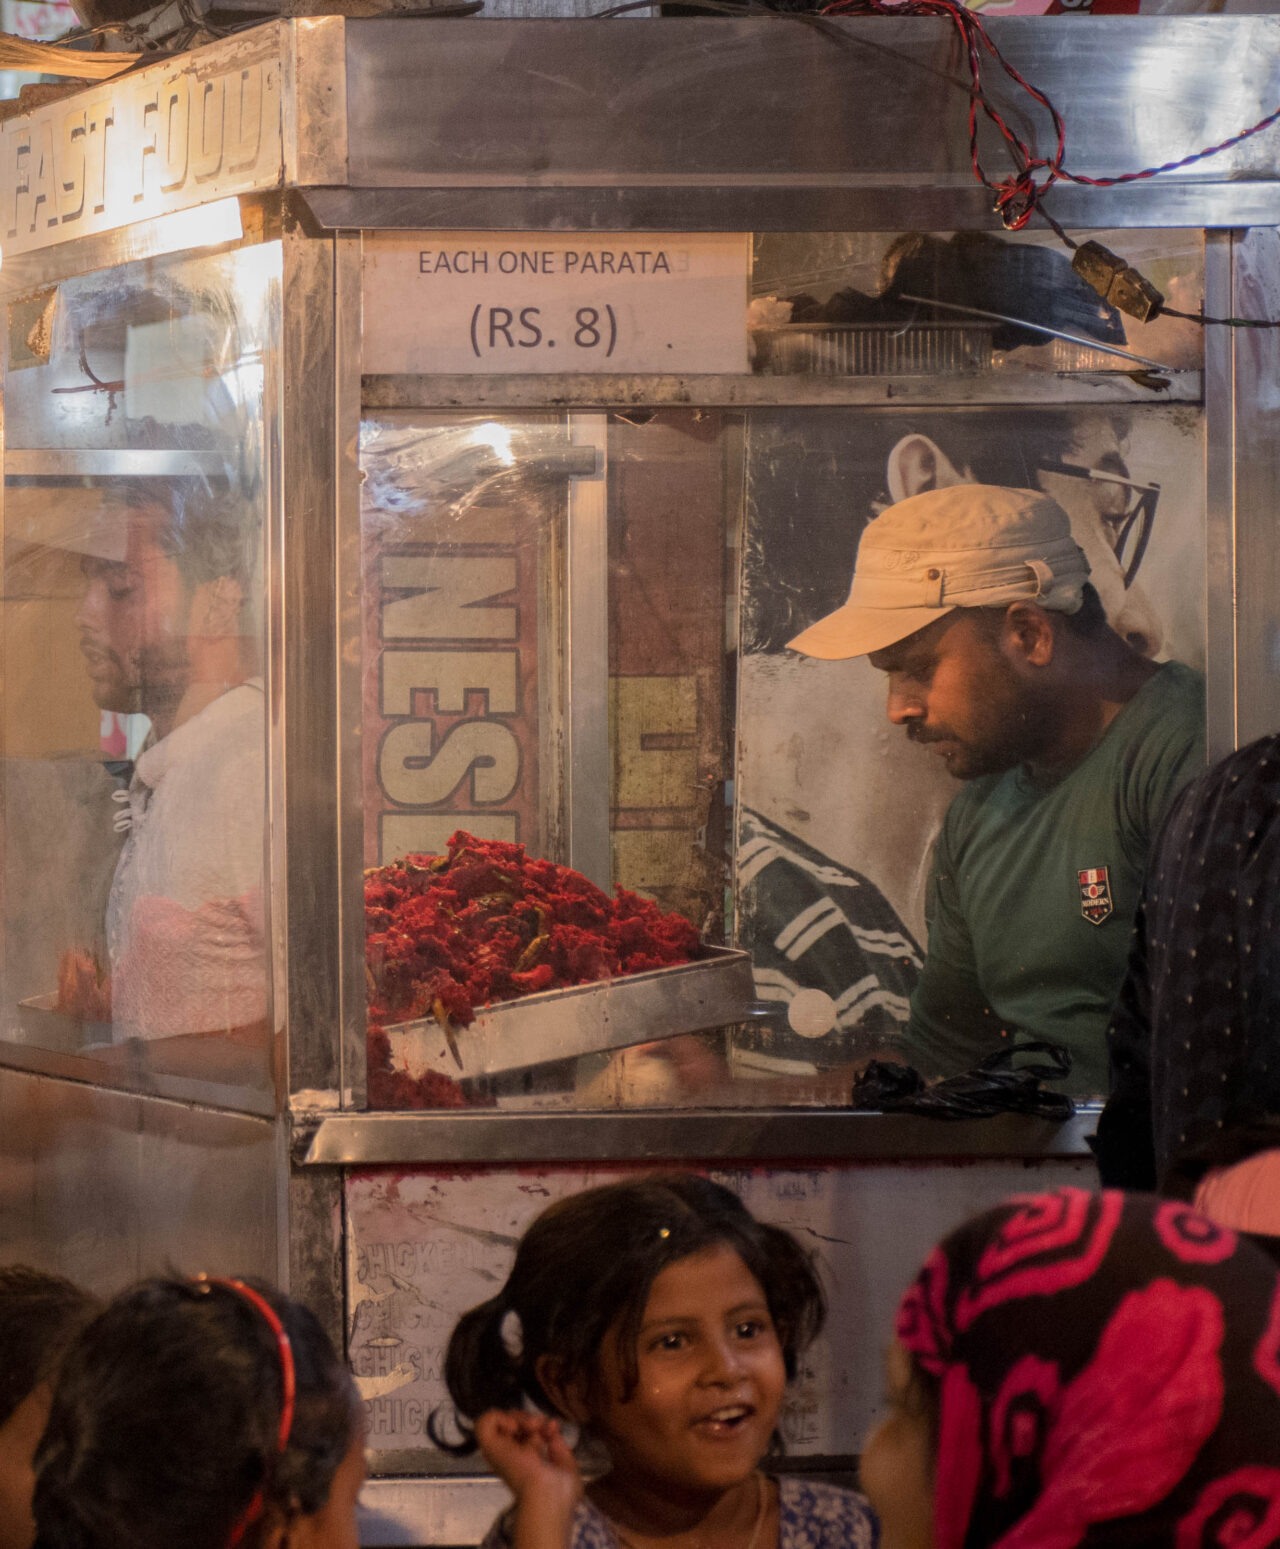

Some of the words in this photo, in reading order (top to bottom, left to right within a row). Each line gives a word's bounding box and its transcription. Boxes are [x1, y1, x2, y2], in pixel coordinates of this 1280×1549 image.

[5, 101, 114, 239] FAST
[419, 250, 489, 274] EACH
[498, 250, 555, 274] ONE
[564, 250, 671, 274] PARATA
[470, 303, 556, 358] (RS.
[574, 303, 618, 358] 8)
